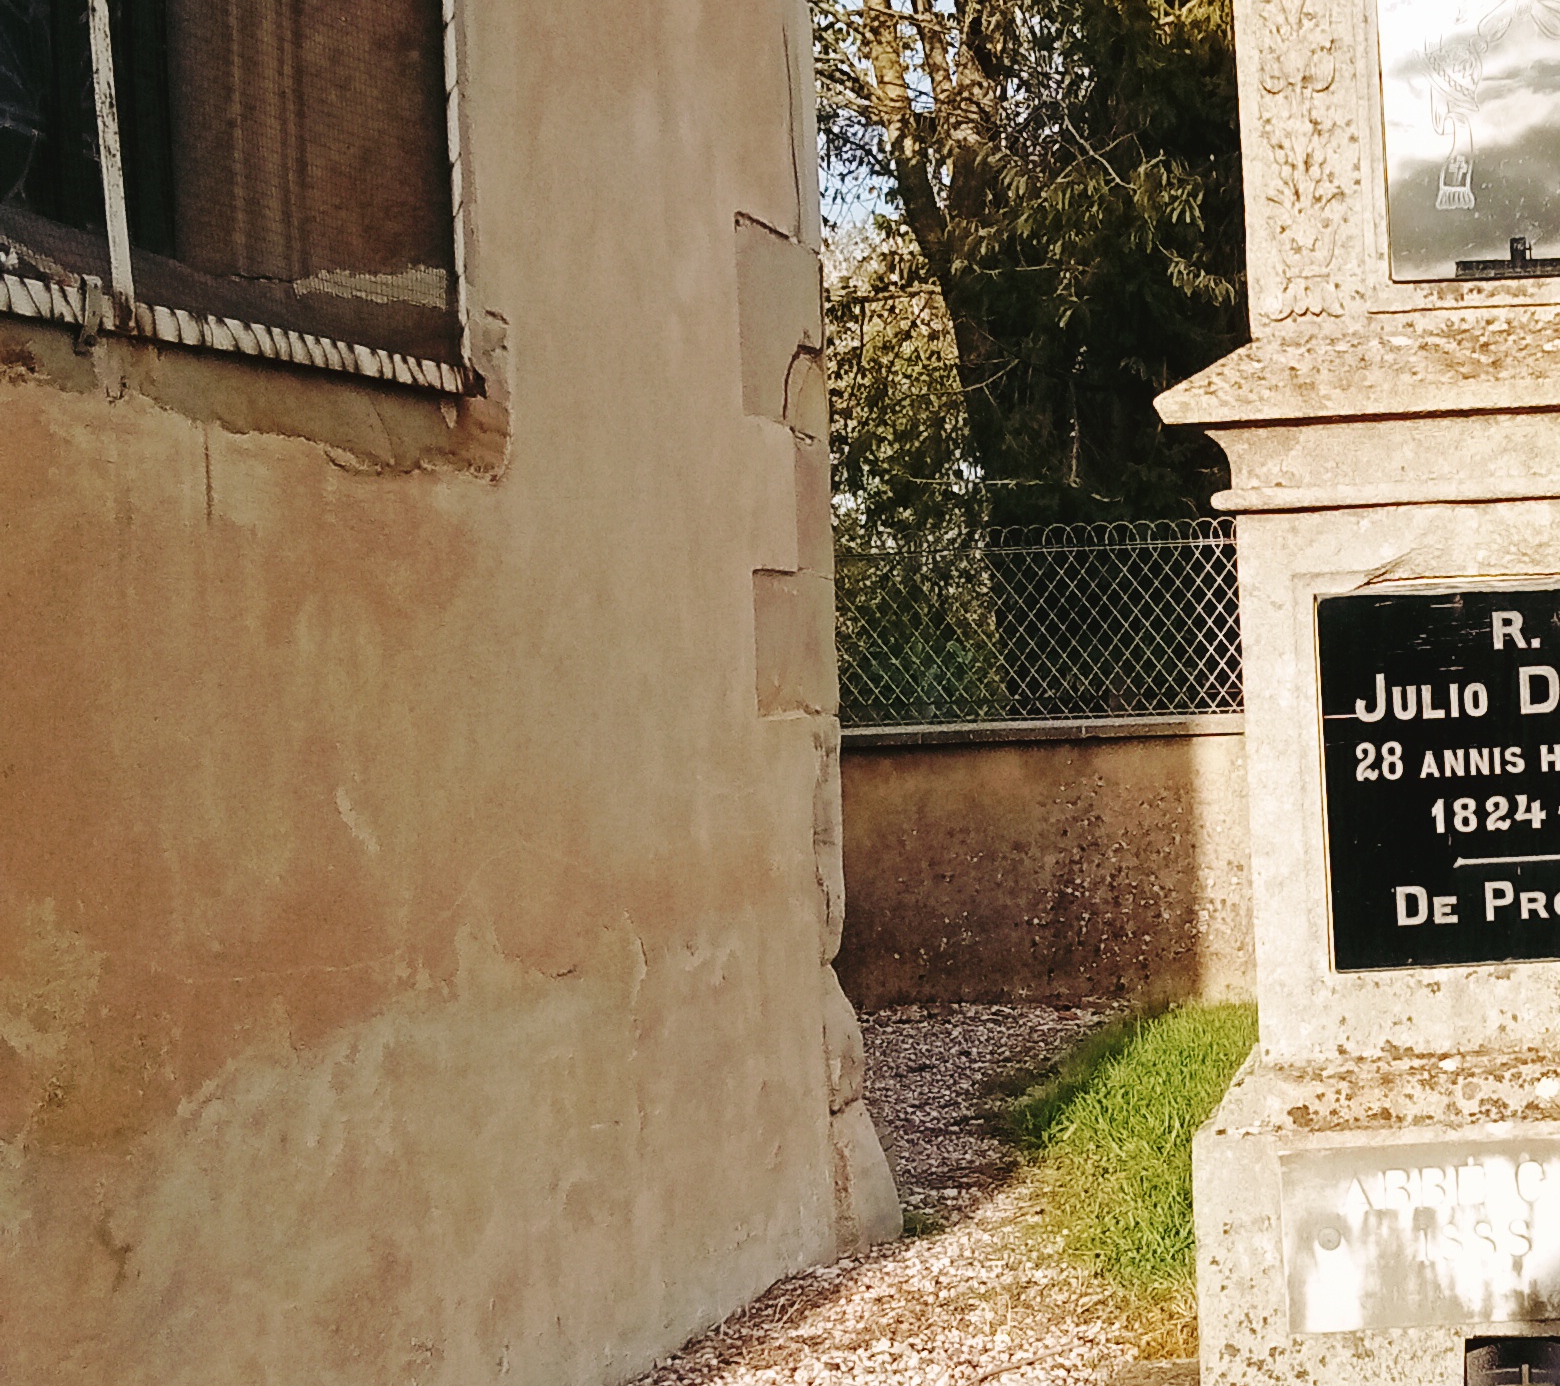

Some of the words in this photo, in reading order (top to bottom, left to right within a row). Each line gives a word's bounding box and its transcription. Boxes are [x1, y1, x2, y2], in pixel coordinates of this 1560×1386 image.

[1491, 610, 1541, 650] R.
[1355, 740, 1404, 782] 28
[1419, 746, 1526, 779] ANNIS
